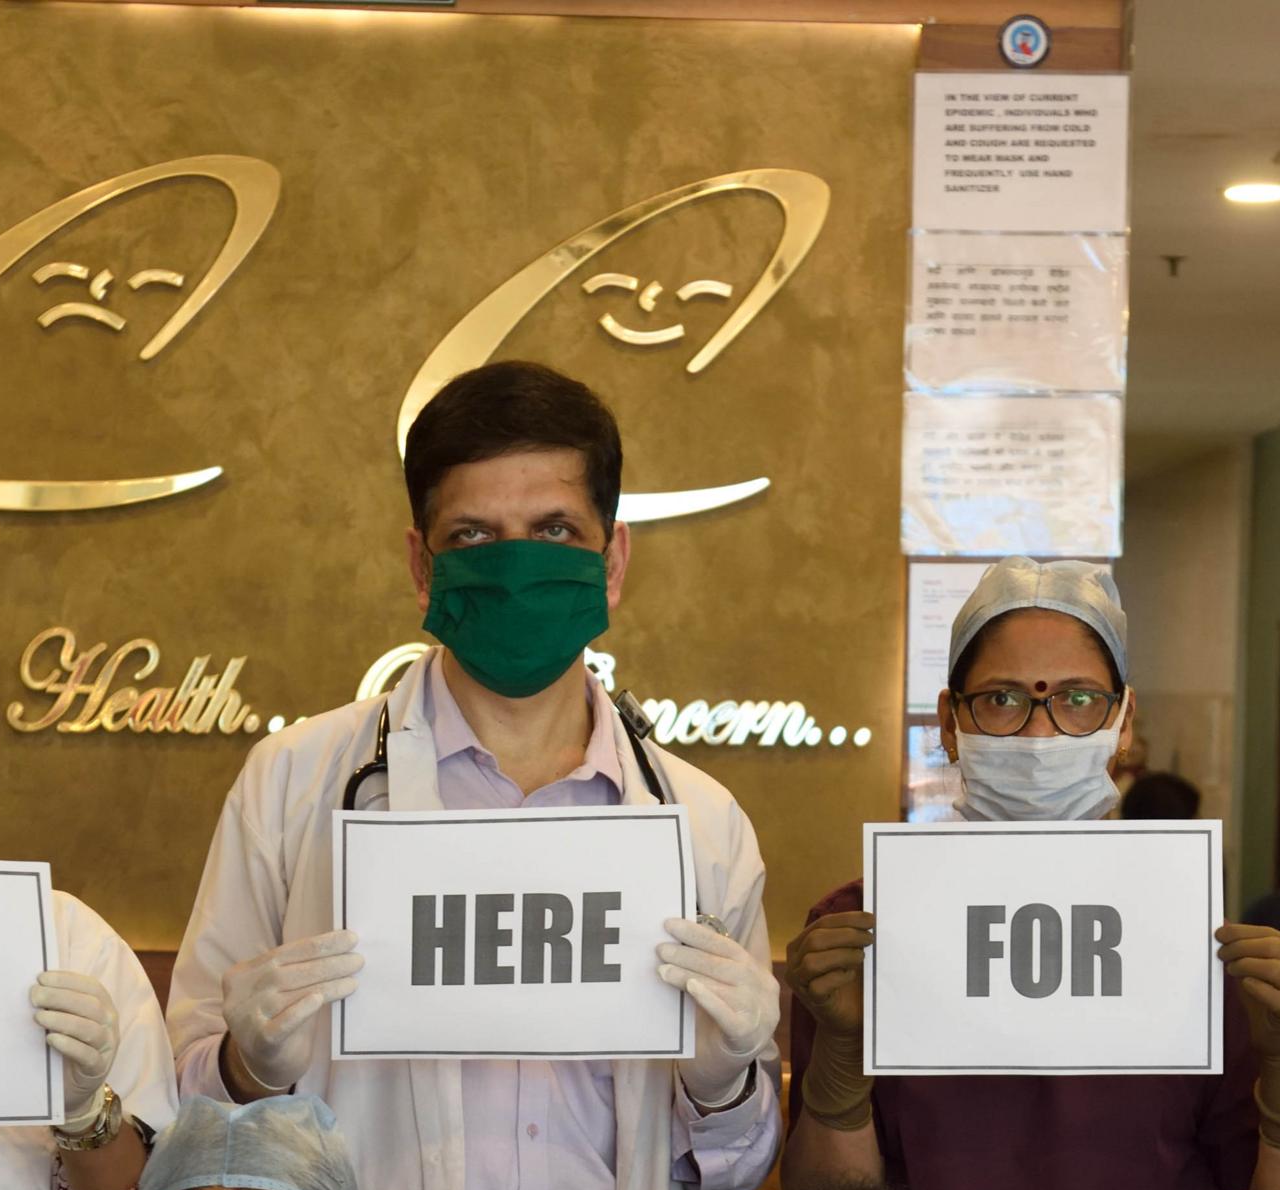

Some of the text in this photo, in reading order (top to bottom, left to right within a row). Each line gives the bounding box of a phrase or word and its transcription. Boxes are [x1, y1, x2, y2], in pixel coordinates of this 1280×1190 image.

[945, 109, 995, 117] EPIDEMIC
[1004, 109, 1070, 117] INDIVIDUALS
[1073, 109, 1098, 117] WHO
[945, 124, 1091, 132] ARE SUFFERING FROM COLD
[945, 139, 1096, 147] AND COUGH ARE REQUESTED
[945, 154, 1049, 162] TO WEAR MASK AND
[945, 169, 1073, 177] FREQUENTLY USE HAND
[944, 184, 999, 192] SANITIZER
[412, 892, 621, 985] HERE
[967, 904, 1122, 998] FOR
